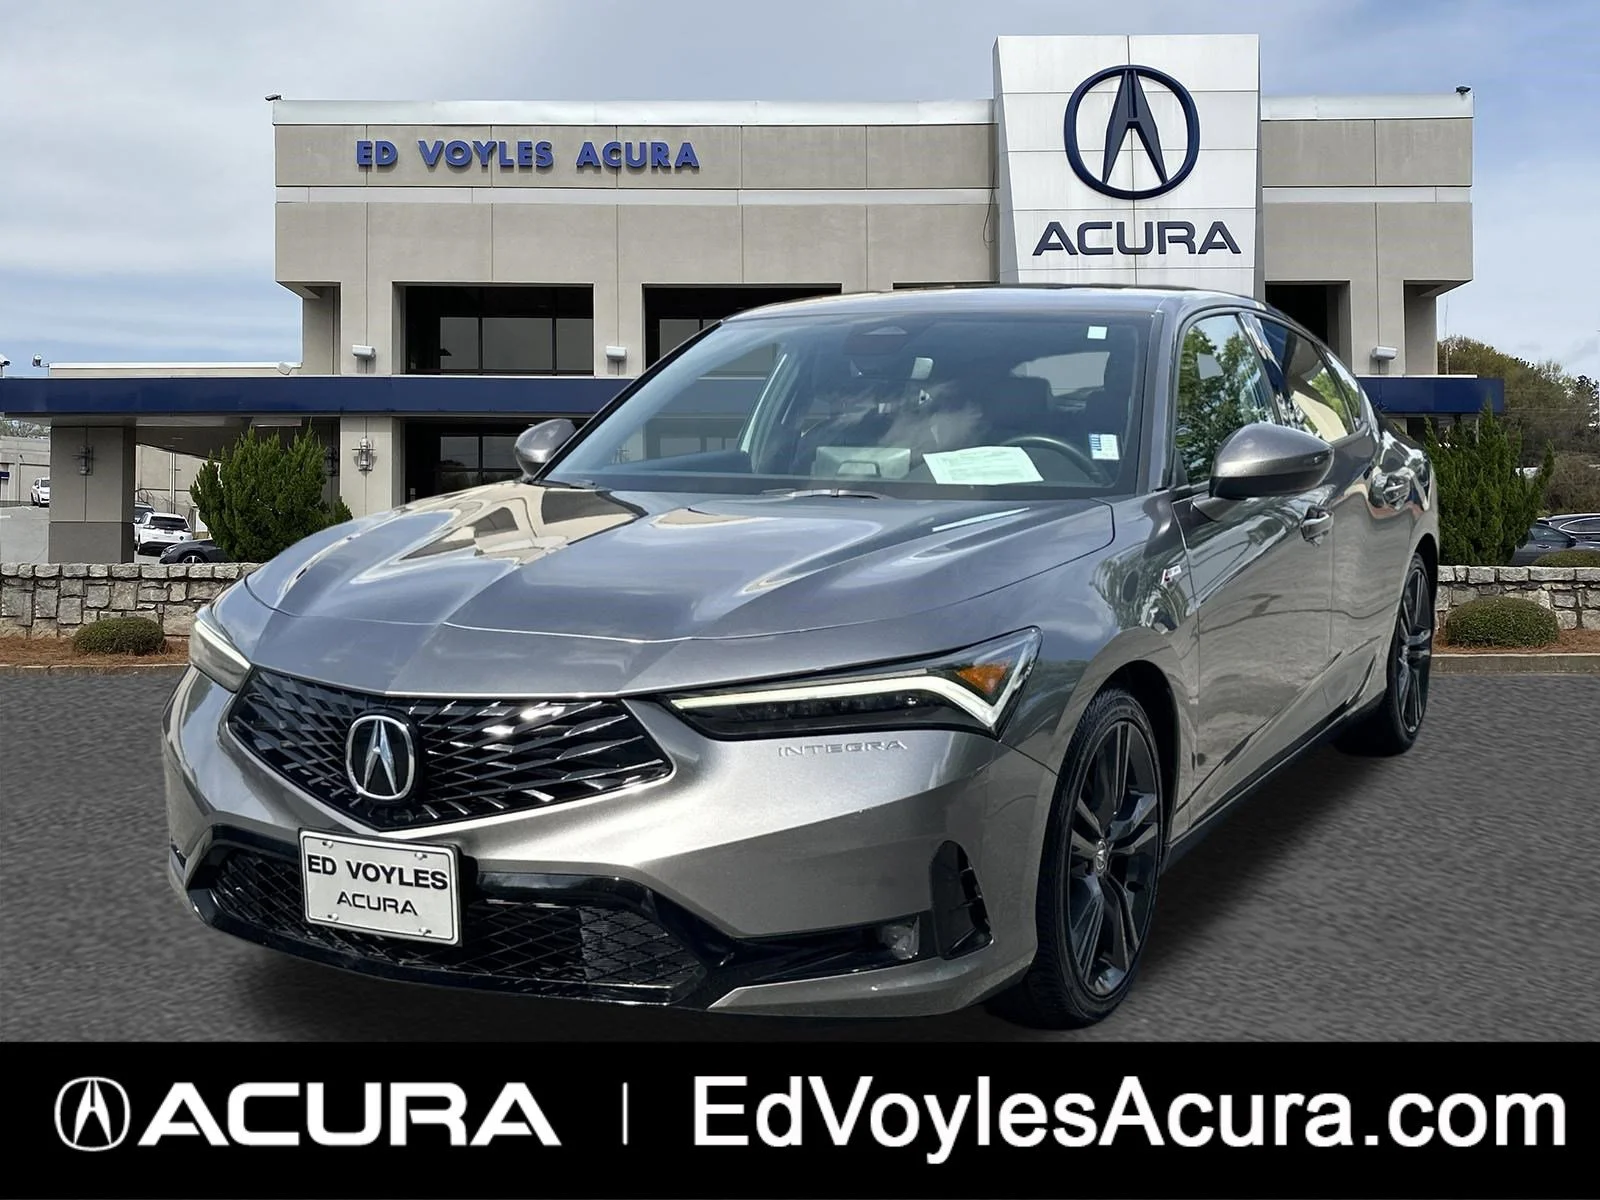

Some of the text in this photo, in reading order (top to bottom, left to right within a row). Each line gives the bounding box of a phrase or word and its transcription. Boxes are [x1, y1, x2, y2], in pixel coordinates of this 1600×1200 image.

[356, 140, 700, 168] ED VOYLES ACURA
[1032, 221, 1242, 256] ACURA
[778, 740, 908, 757] INTEGRA
[307, 854, 448, 890] ED VOYLES
[336, 891, 418, 916] ACURA
